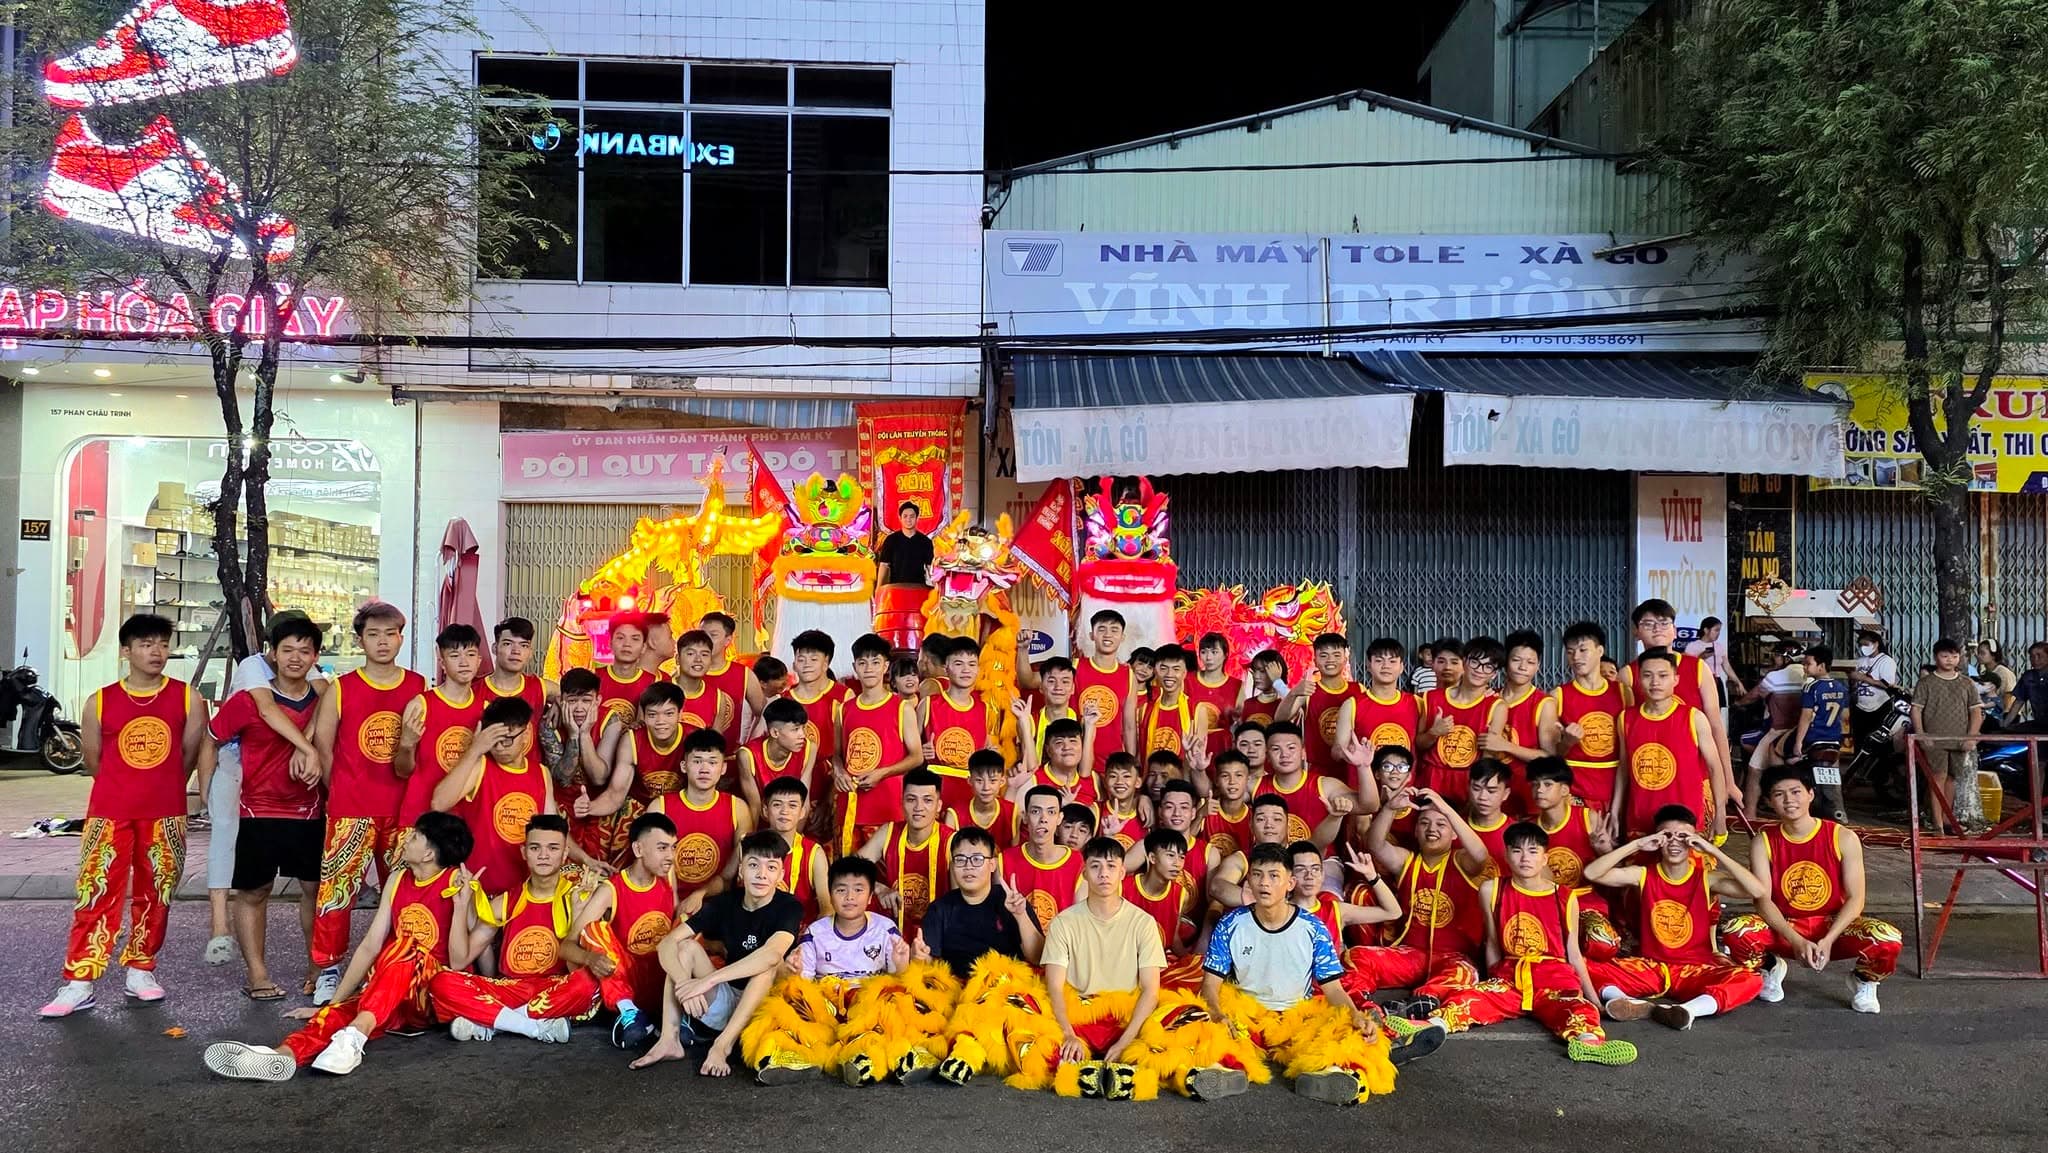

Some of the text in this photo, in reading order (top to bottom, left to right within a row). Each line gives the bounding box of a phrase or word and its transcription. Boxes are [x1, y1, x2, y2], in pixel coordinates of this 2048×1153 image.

[1100, 239, 1198, 263] NHÀ
[1216, 240, 1320, 263] MÁY
[1341, 244, 1466, 264] TOLE
[1519, 241, 1584, 265] XÀ
[1063, 271, 1291, 326] VĨNH
[86, 408, 108, 417] CHÂU
[110, 409, 132, 417] TRINH
[572, 433, 593, 446] ỦY
[595, 436, 625, 446] BAN
[627, 433, 667, 445] NHÂN
[669, 431, 697, 444] DÂN
[702, 431, 747, 443] THÀNH
[782, 431, 814, 441] TAM
[877, 431, 889, 440] ĐỘI
[889, 431, 903, 439] LÂN
[1018, 419, 1063, 467] TÔN
[1084, 419, 1113, 465] XÀ
[1119, 411, 1149, 463] GỒ
[1449, 401, 1495, 454] TÔN
[1515, 406, 1545, 455] XÀ
[1551, 402, 1581, 456] GỒ
[2003, 432, 2035, 455] THI
[521, 451, 589, 480] ĐỘI
[602, 453, 677, 478] QUY
[895, 469, 934, 493] XÓM
[23, 521, 48, 534] 157
[1825, 701, 1841, 728] 7
